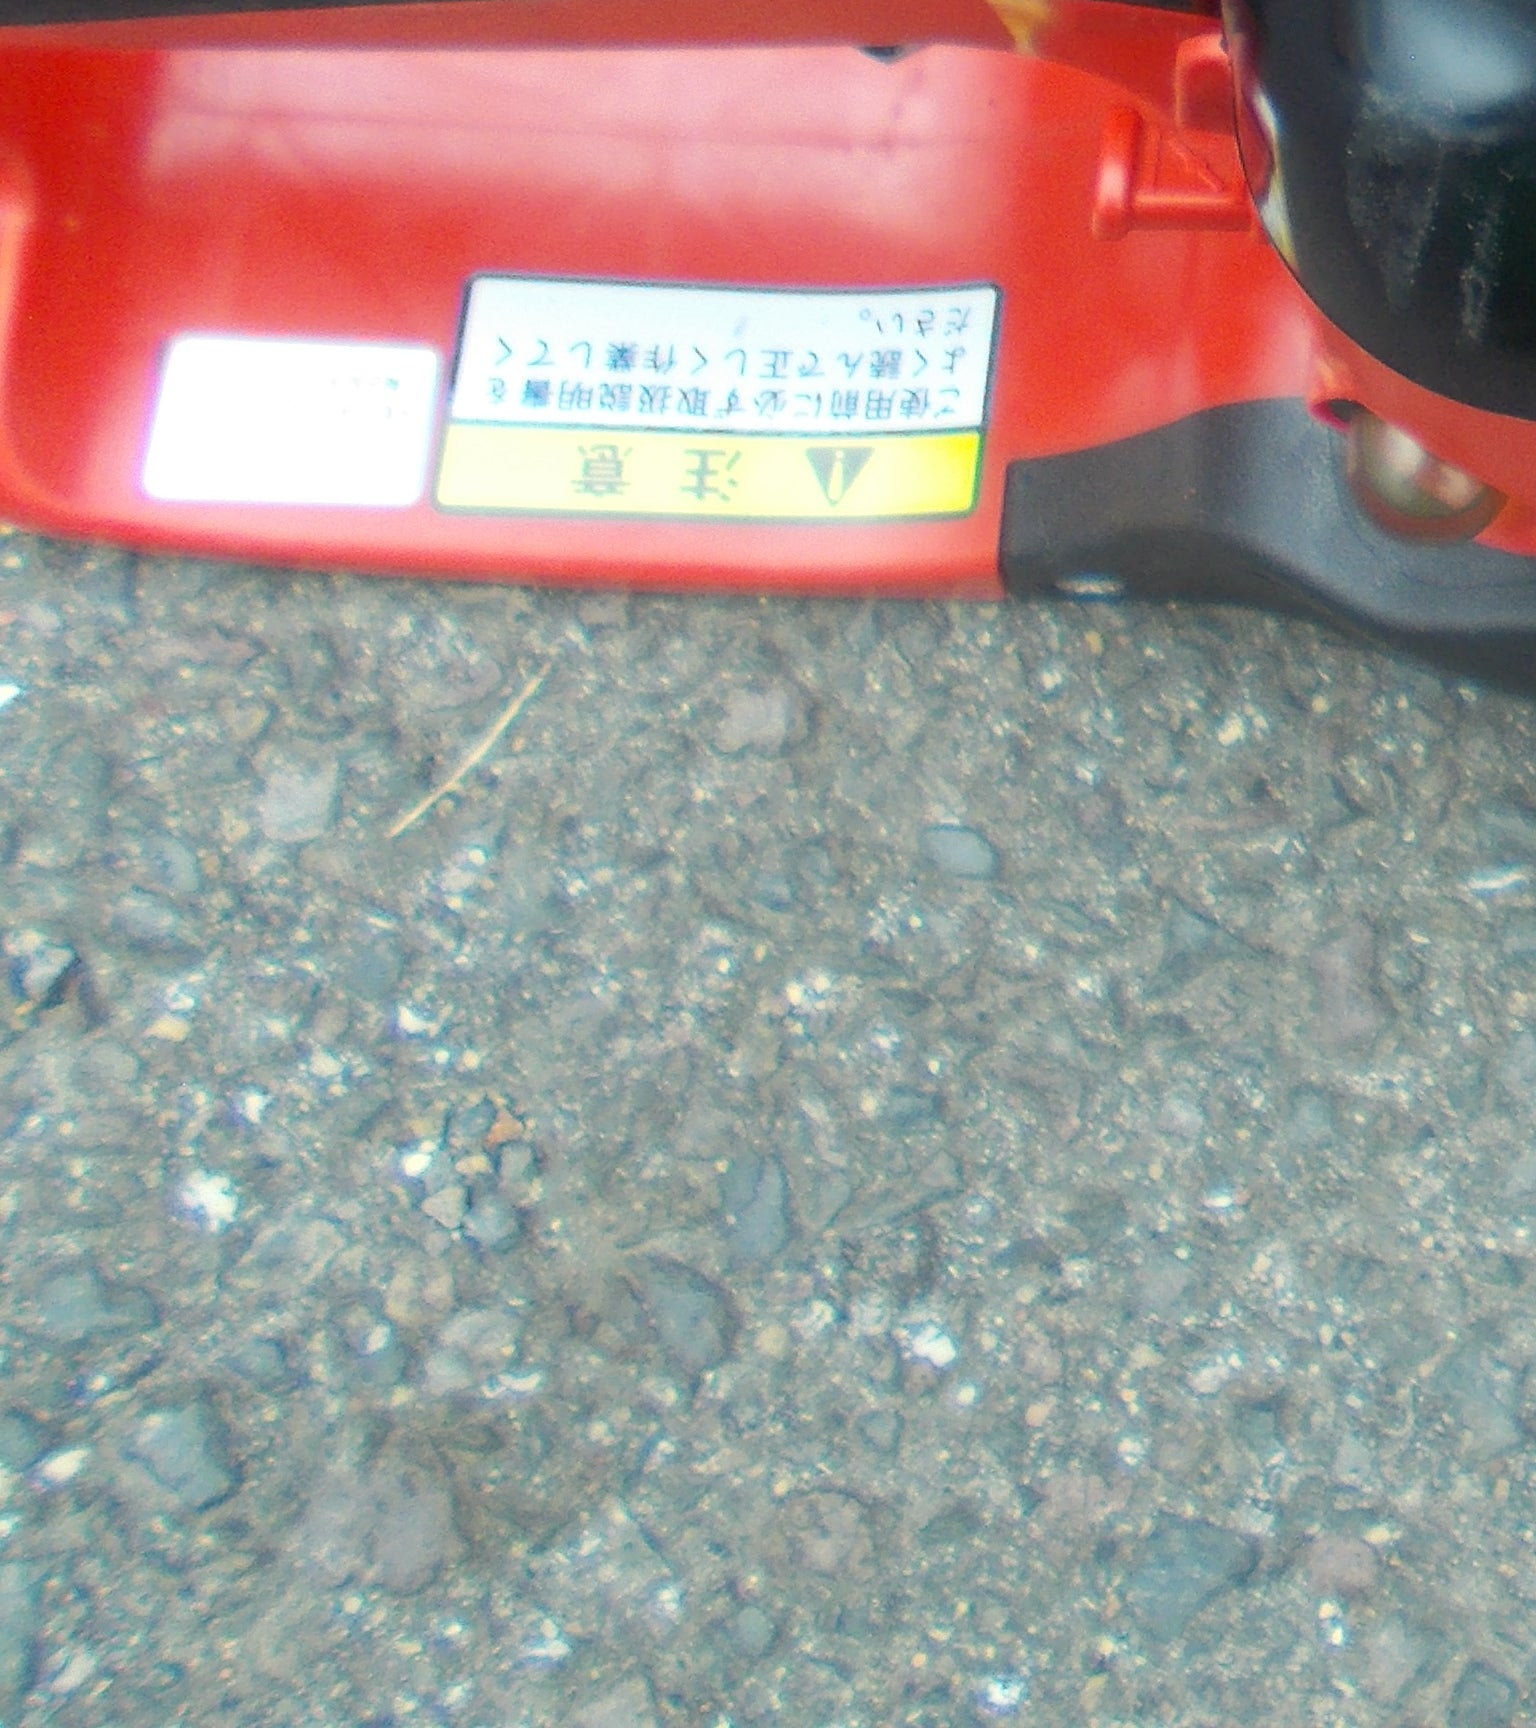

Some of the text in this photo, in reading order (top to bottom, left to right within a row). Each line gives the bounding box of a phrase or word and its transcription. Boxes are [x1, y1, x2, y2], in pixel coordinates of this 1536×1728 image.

[496, 336, 971, 381] よく読んで正しく作業してく
[486, 376, 963, 421] ご使用前に必ず取扱説明書を
